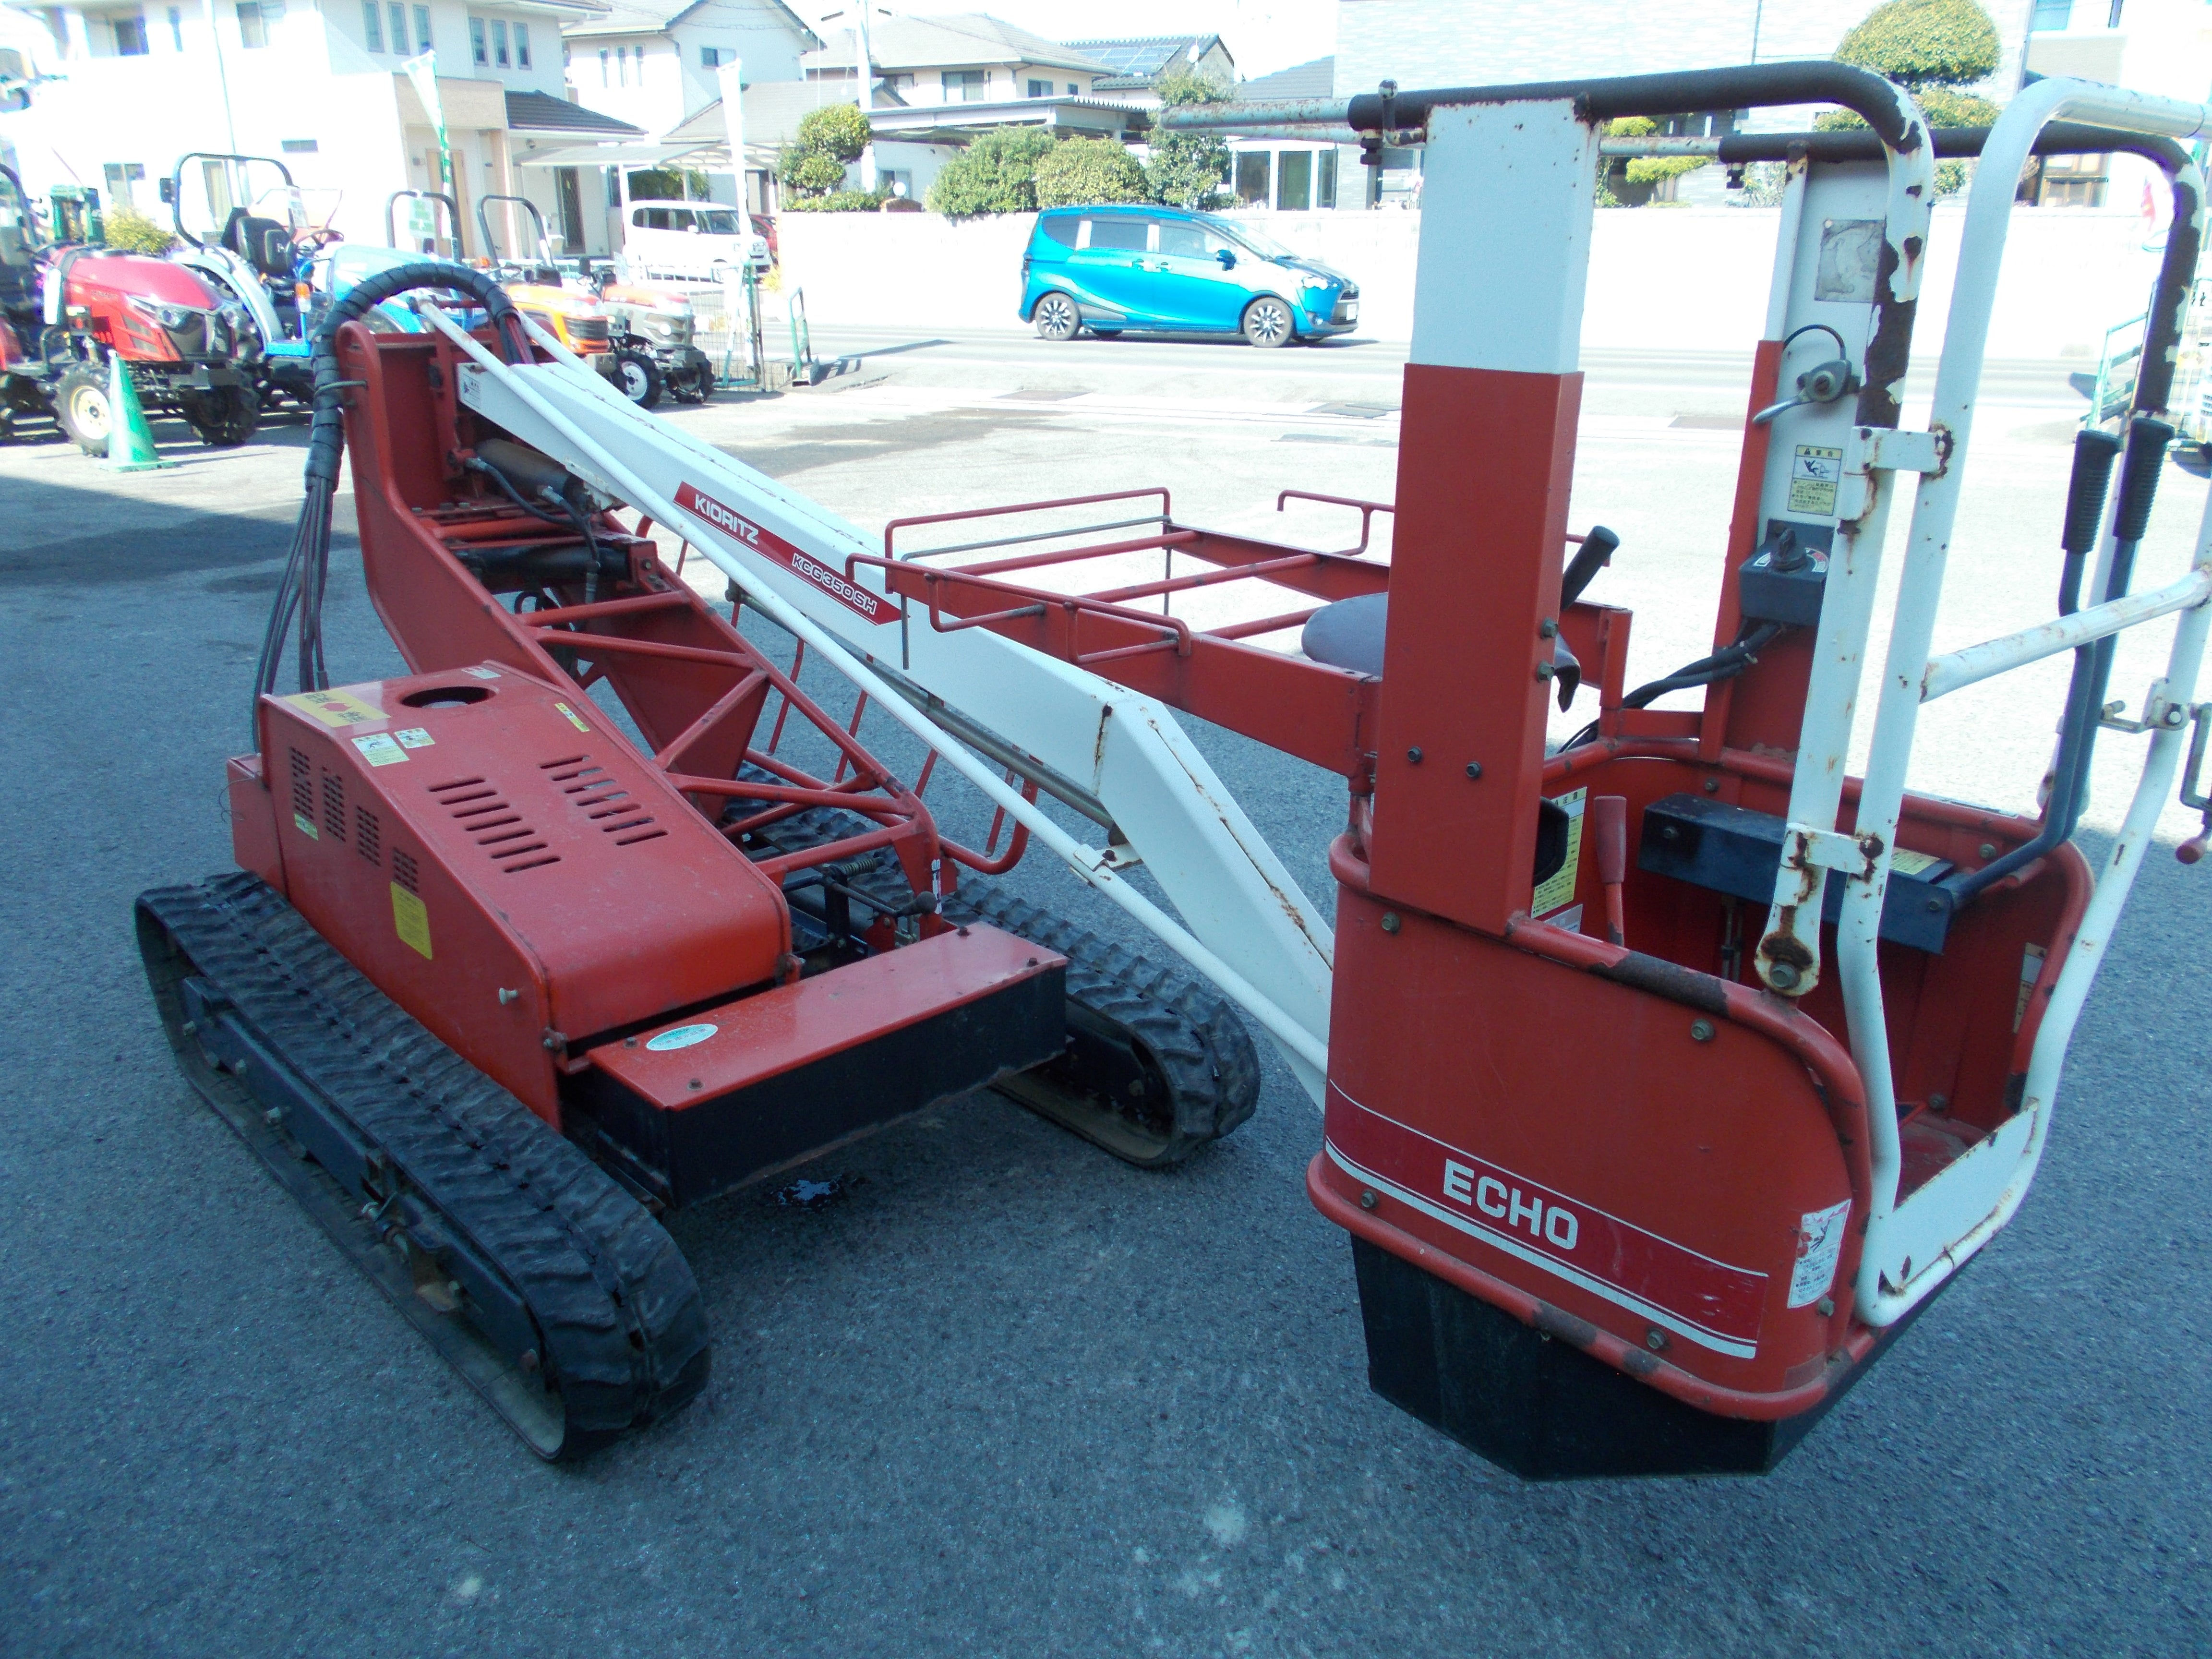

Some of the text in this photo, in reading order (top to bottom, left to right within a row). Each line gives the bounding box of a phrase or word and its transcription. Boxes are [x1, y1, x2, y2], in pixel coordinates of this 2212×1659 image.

[695, 494, 759, 545] KIORITZ
[792, 553, 878, 615] KCG350SH
[1443, 1158, 1578, 1250] ECHO
